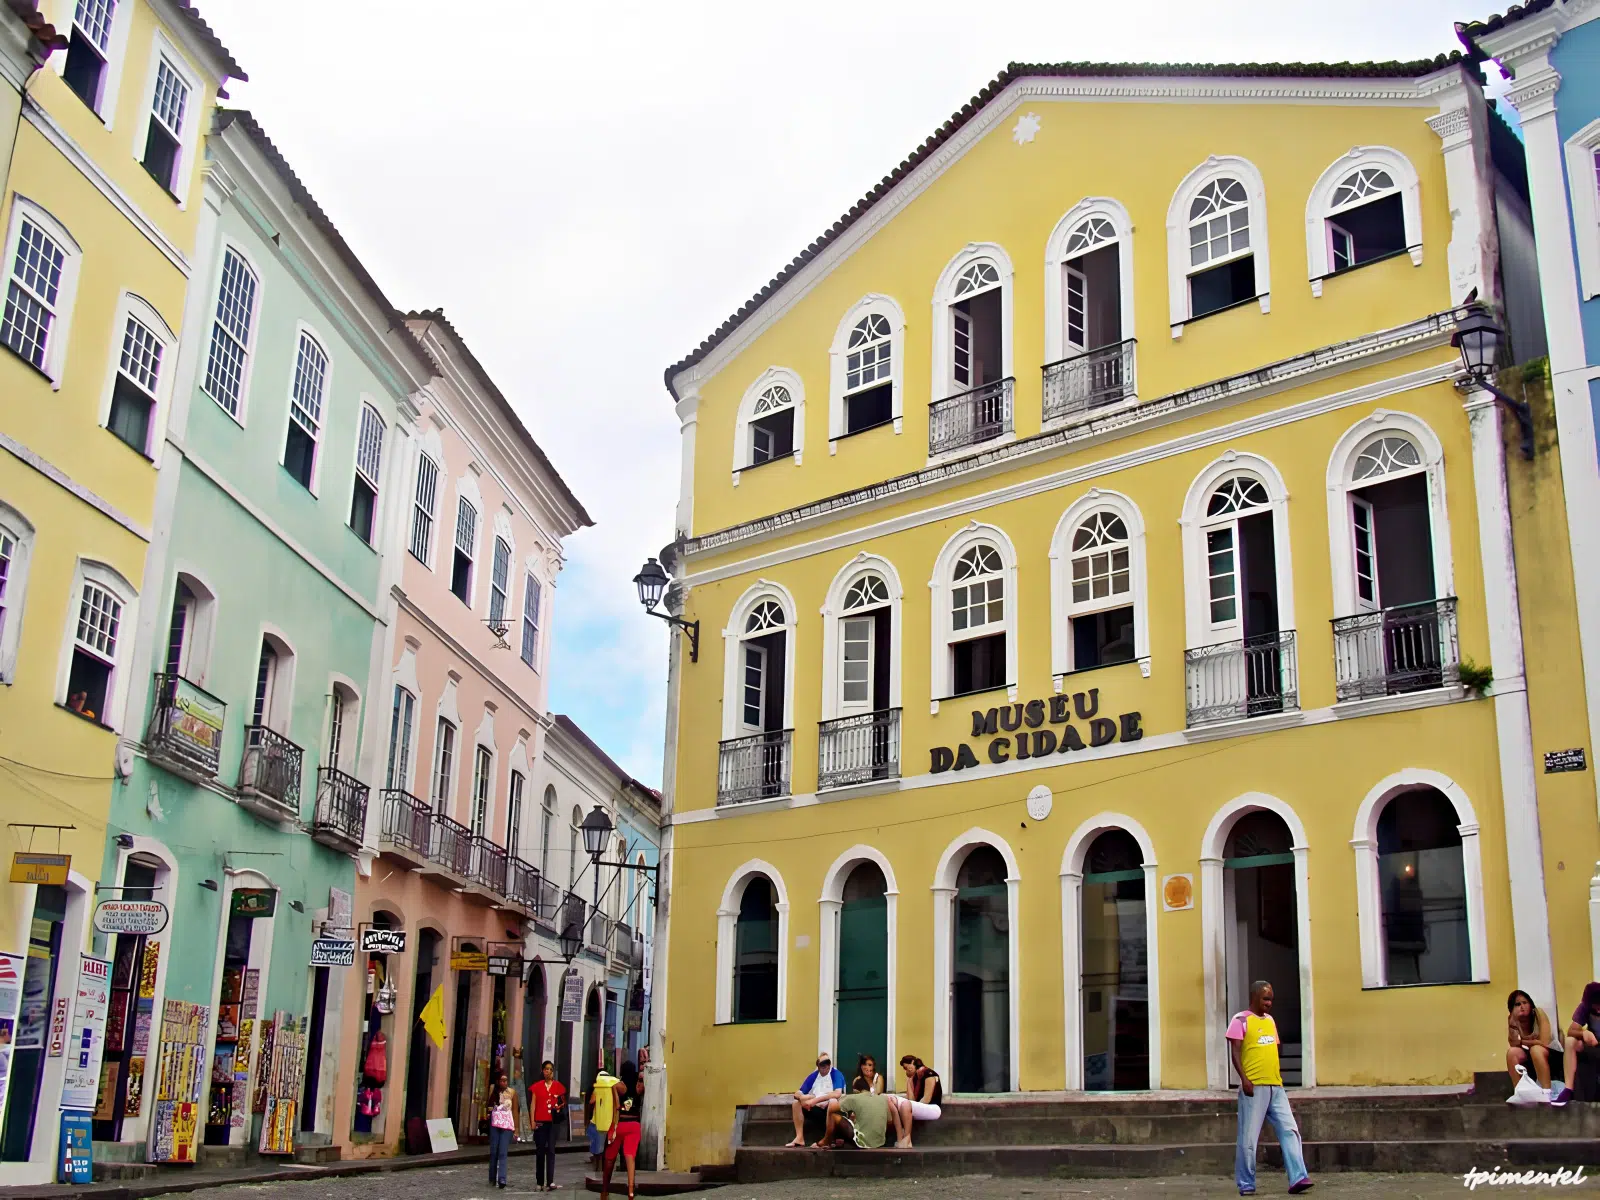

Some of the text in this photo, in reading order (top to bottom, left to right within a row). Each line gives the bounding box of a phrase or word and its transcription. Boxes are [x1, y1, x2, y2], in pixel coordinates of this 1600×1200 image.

[971, 688, 1100, 737] MUSEU
[929, 711, 1144, 774] DA CIDADE
